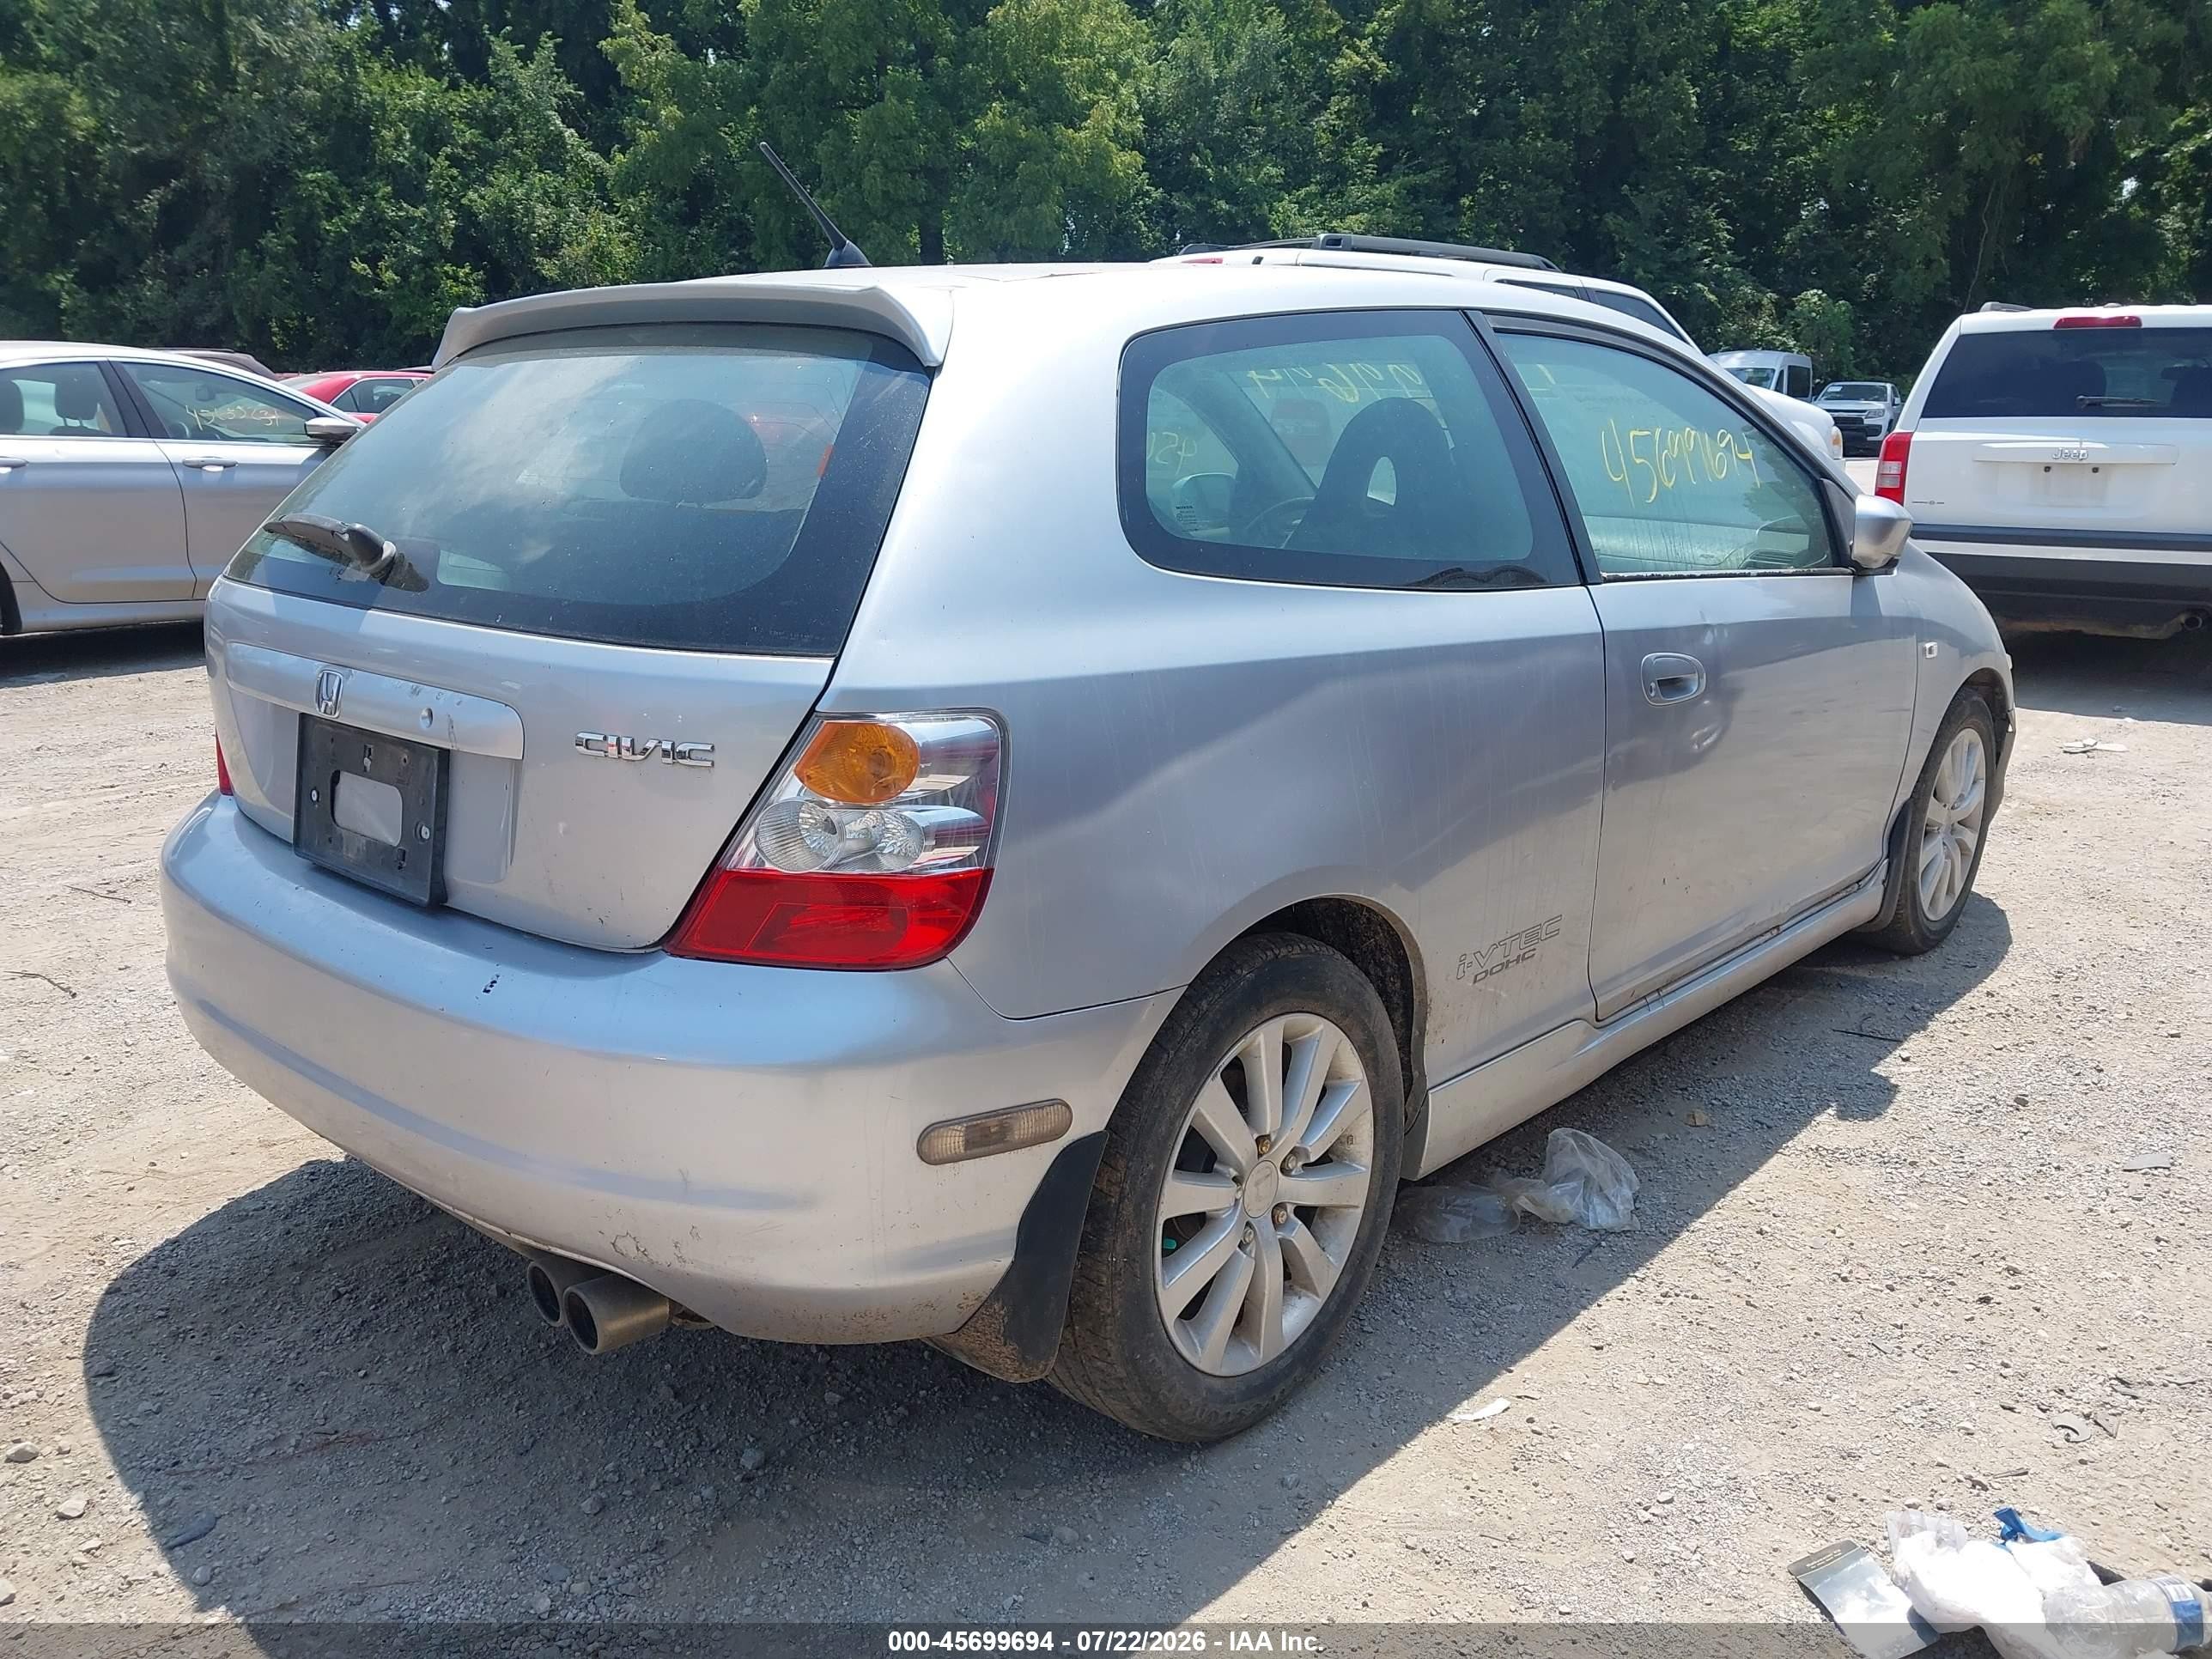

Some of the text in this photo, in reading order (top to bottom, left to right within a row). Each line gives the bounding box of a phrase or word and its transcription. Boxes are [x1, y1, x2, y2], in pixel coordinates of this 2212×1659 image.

[1601, 418, 1761, 508] 45699694
[2052, 447, 2088, 461] Jeep
[574, 731, 715, 768] CIVIC
[1456, 915, 1563, 981] i-VTEC
[1472, 948, 1536, 984] DOHC
